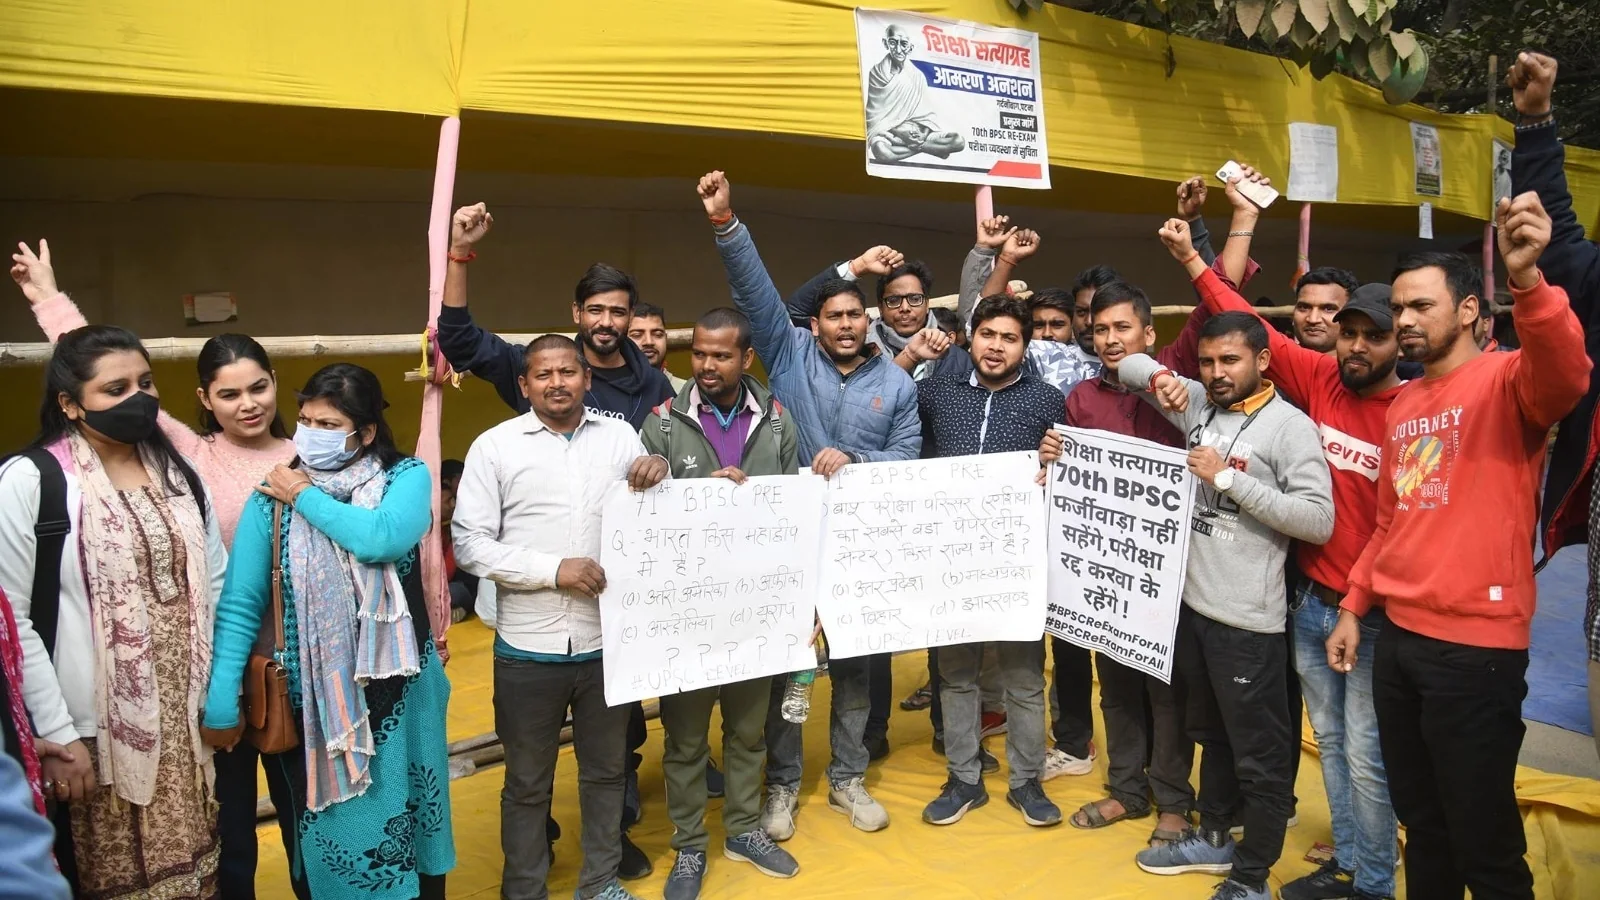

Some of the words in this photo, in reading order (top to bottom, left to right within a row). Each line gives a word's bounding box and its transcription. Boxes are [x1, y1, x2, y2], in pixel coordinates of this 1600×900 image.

[922, 24, 970, 58] शिक्षा
[971, 40, 1031, 68] सत्याग्रह
[933, 66, 983, 92] आमरण
[987, 76, 1033, 98] अनशन
[972, 127, 988, 138] 70th
[989, 129, 1006, 140] BPSC
[1007, 131, 1037, 143] RE-EXAM
[1391, 408, 1463, 441] JOURNEY
[1060, 434, 1102, 463] शिक्षा
[1108, 449, 1185, 484] सत्याग्रह
[753, 484, 782, 515] PRE
[1056, 462, 1108, 494] 70th
[1114, 476, 1181, 511] BPSC
[642, 528, 692, 554] भारत
[701, 521, 736, 553] किस
[832, 528, 860, 544] का
[863, 518, 908, 544] सबसे
[1053, 494, 1136, 534] फर्जीवाड़ा
[1142, 518, 1180, 545] नहीं
[939, 542, 974, 566] राज्य
[1060, 551, 1083, 577] रद्द
[1088, 559, 1135, 592] करवा
[1140, 572, 1161, 600] के
[1045, 616, 1165, 671] #BPSCReExamForAll
[1047, 602, 1168, 657] #BPSCReExamForAll
